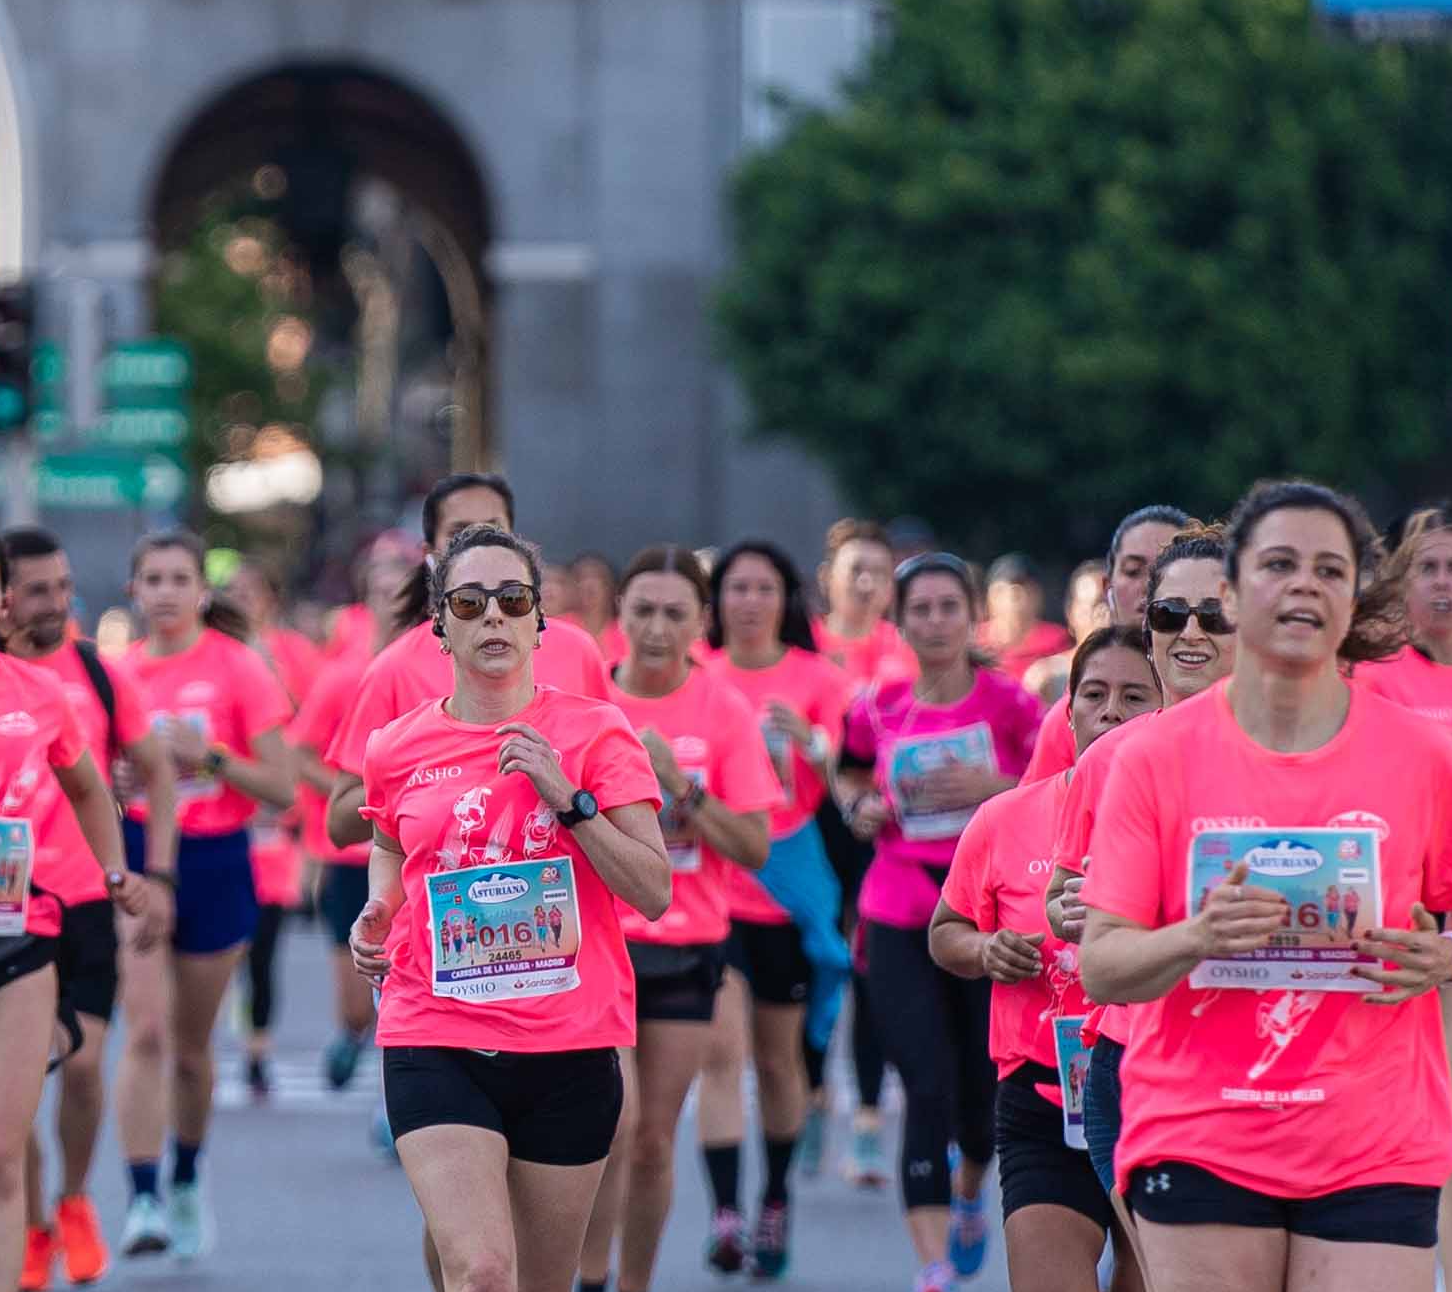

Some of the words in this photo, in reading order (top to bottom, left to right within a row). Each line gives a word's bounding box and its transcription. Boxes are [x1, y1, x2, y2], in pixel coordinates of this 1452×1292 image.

[544, 867, 558, 878] 20
[1029, 860, 1053, 875] OY
[470, 885, 527, 900] ASTURIANA
[479, 922, 533, 947] 016
[488, 950, 522, 963] 24465
[1254, 949, 1266, 958] DE
[1268, 949, 1280, 958] LA
[1283, 949, 1313, 959] MUJER
[451, 968, 481, 979] CARRERA
[483, 967, 493, 976] DE
[494, 965, 504, 974] LA
[505, 962, 530, 973] MUJER
[535, 958, 566, 969] MADRID
[1210, 966, 1270, 980] OYSHO
[450, 982, 496, 996] OYSHO
[525, 976, 567, 988] Santander
[1264, 1091, 1276, 1102] DE
[1278, 1090, 1290, 1102] LA
